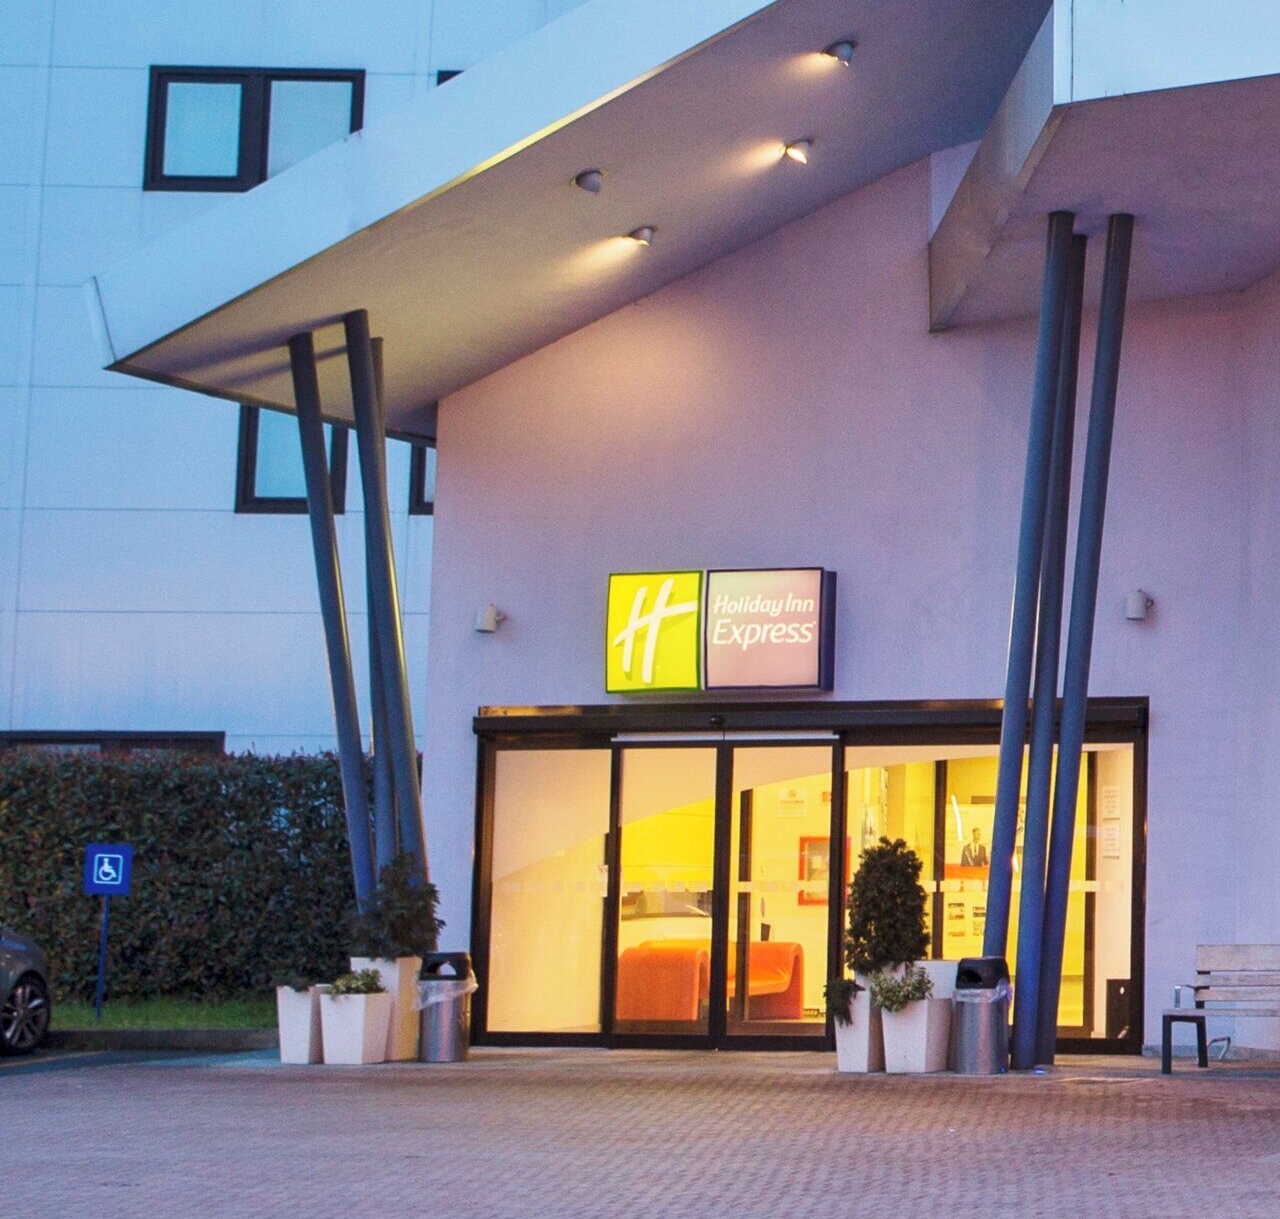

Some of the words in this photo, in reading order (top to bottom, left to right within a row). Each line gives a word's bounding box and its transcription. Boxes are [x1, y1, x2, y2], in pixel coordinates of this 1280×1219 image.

[712, 595, 784, 617] Holiday
[784, 593, 815, 613] Inn
[613, 578, 698, 683] H
[712, 619, 814, 651] Express
